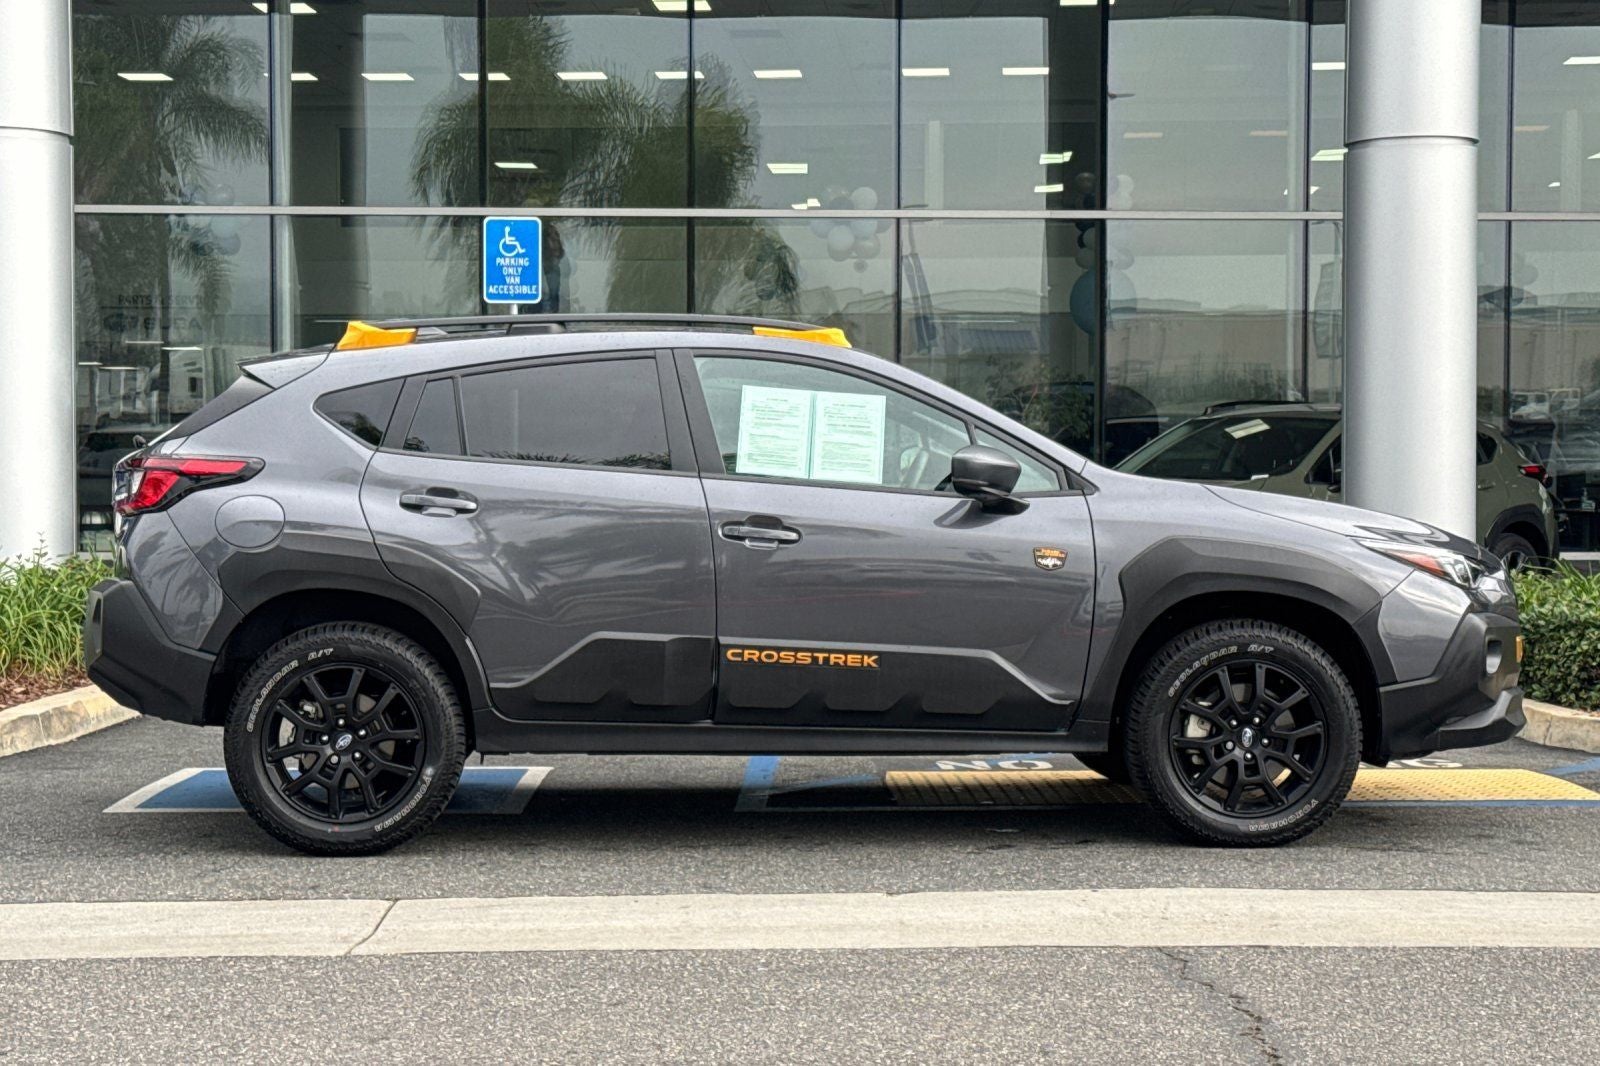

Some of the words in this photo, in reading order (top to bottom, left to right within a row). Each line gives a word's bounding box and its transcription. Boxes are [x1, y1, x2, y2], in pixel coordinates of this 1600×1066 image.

[496, 257, 529, 267] PARKING
[502, 267, 522, 275] ONLY
[505, 276, 520, 284] VAN
[488, 285, 537, 294] ACCESSIBLE
[307, 647, 334, 661] A/T
[726, 648, 879, 668] CROSSTREK
[935, 760, 1053, 770] NO
[374, 775, 432, 833] YOKOHAMA
[1248, 798, 1319, 832] YOKOHAMA
